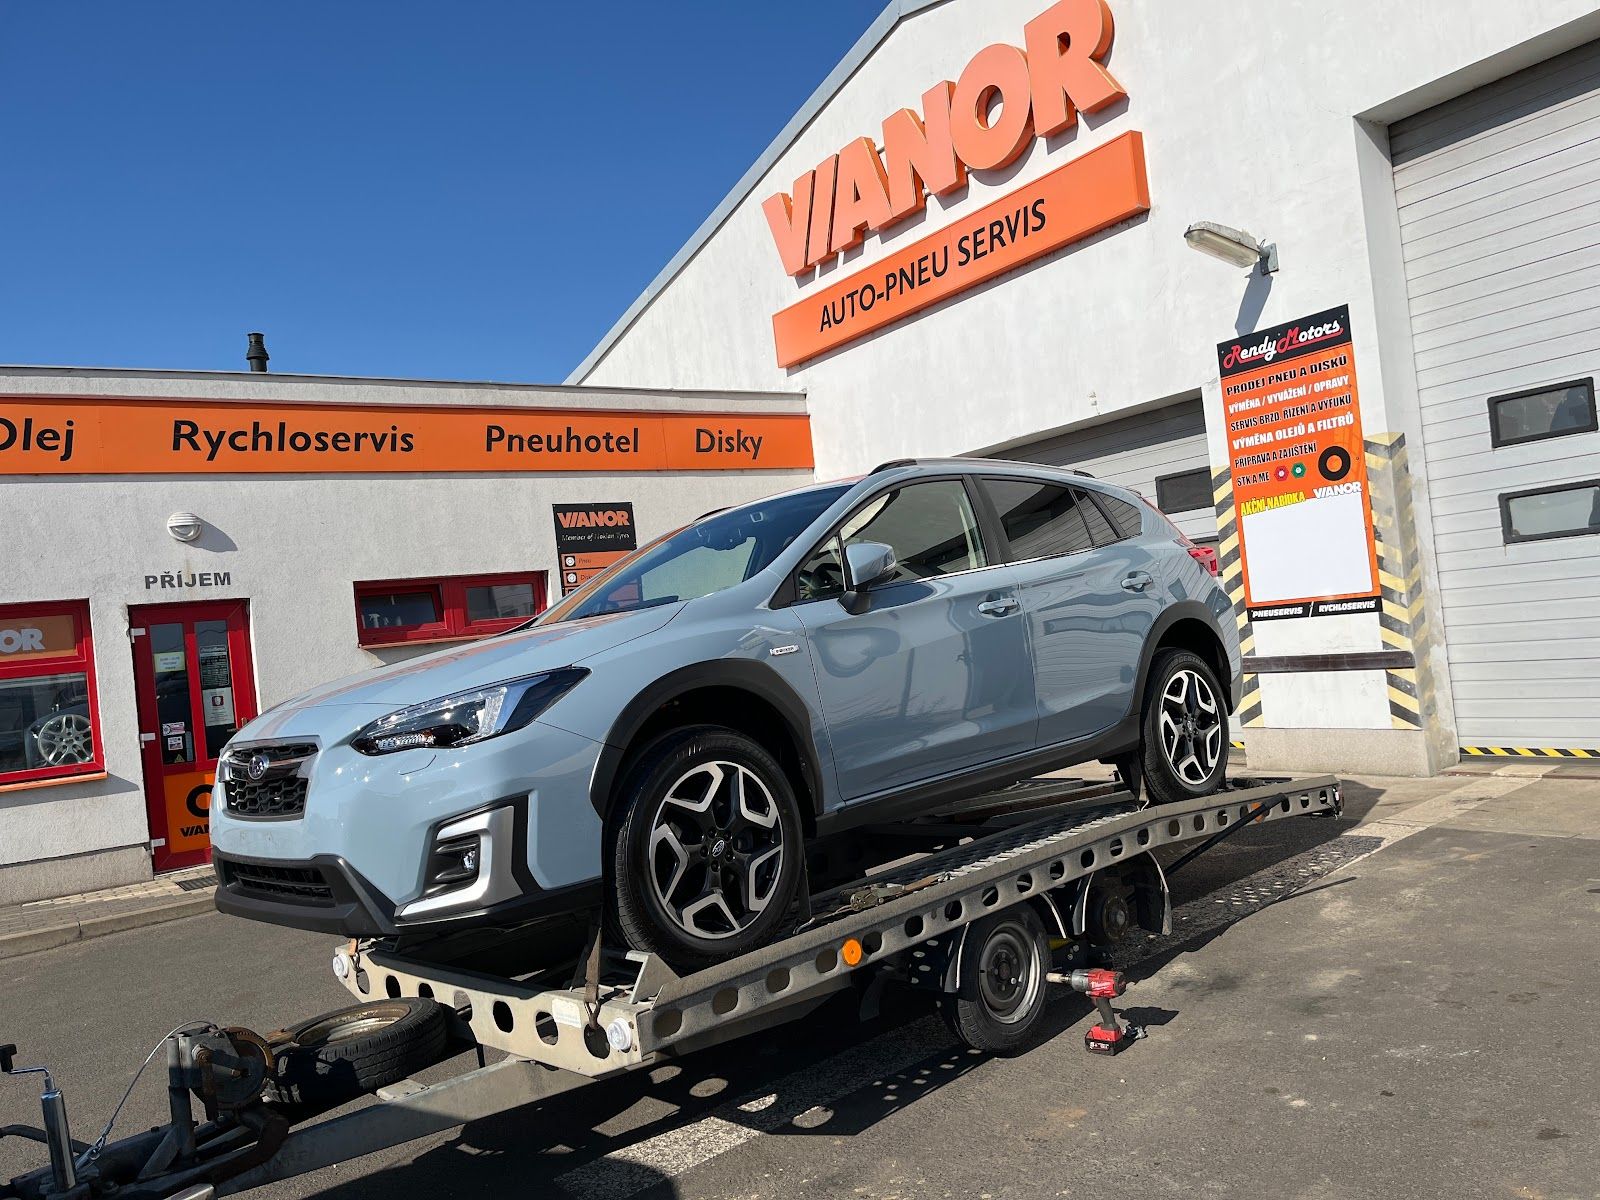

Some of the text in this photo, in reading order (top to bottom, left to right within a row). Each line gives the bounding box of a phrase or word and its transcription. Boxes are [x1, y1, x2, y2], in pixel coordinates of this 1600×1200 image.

[762, 0, 1127, 276] VIANOR
[820, 198, 1047, 332] AUTO-PNEU SERVIS
[1223, 320, 1344, 369] Rendy Motors
[1226, 377, 1265, 396] PRODEJ
[1268, 369, 1297, 385] PNEU
[1299, 366, 1307, 377] A
[1228, 398, 1261, 415] VÝMĚNA
[1313, 375, 1349, 393] OPRAVY
[1230, 416, 1258, 432] SERVIS
[1310, 403, 1316, 413] A
[1232, 411, 1354, 450] VÝMĚNA OLEJŮ A FILTRŮ
[172, 419, 414, 461] Rychloservis
[486, 425, 639, 453] Pneuhotel
[695, 428, 763, 459] Disky
[1272, 450, 1278, 461] A
[1236, 474, 1251, 487] STK
[1252, 474, 1258, 484] A
[1259, 471, 1270, 482] ME
[1312, 481, 1362, 499] VIANOR
[556, 510, 630, 528] VIANOR
[144, 570, 231, 589] PŘÍJEM
[1252, 606, 1303, 618] PNEUSERVIS
[1318, 600, 1376, 613] RYCHLOSERVIS
